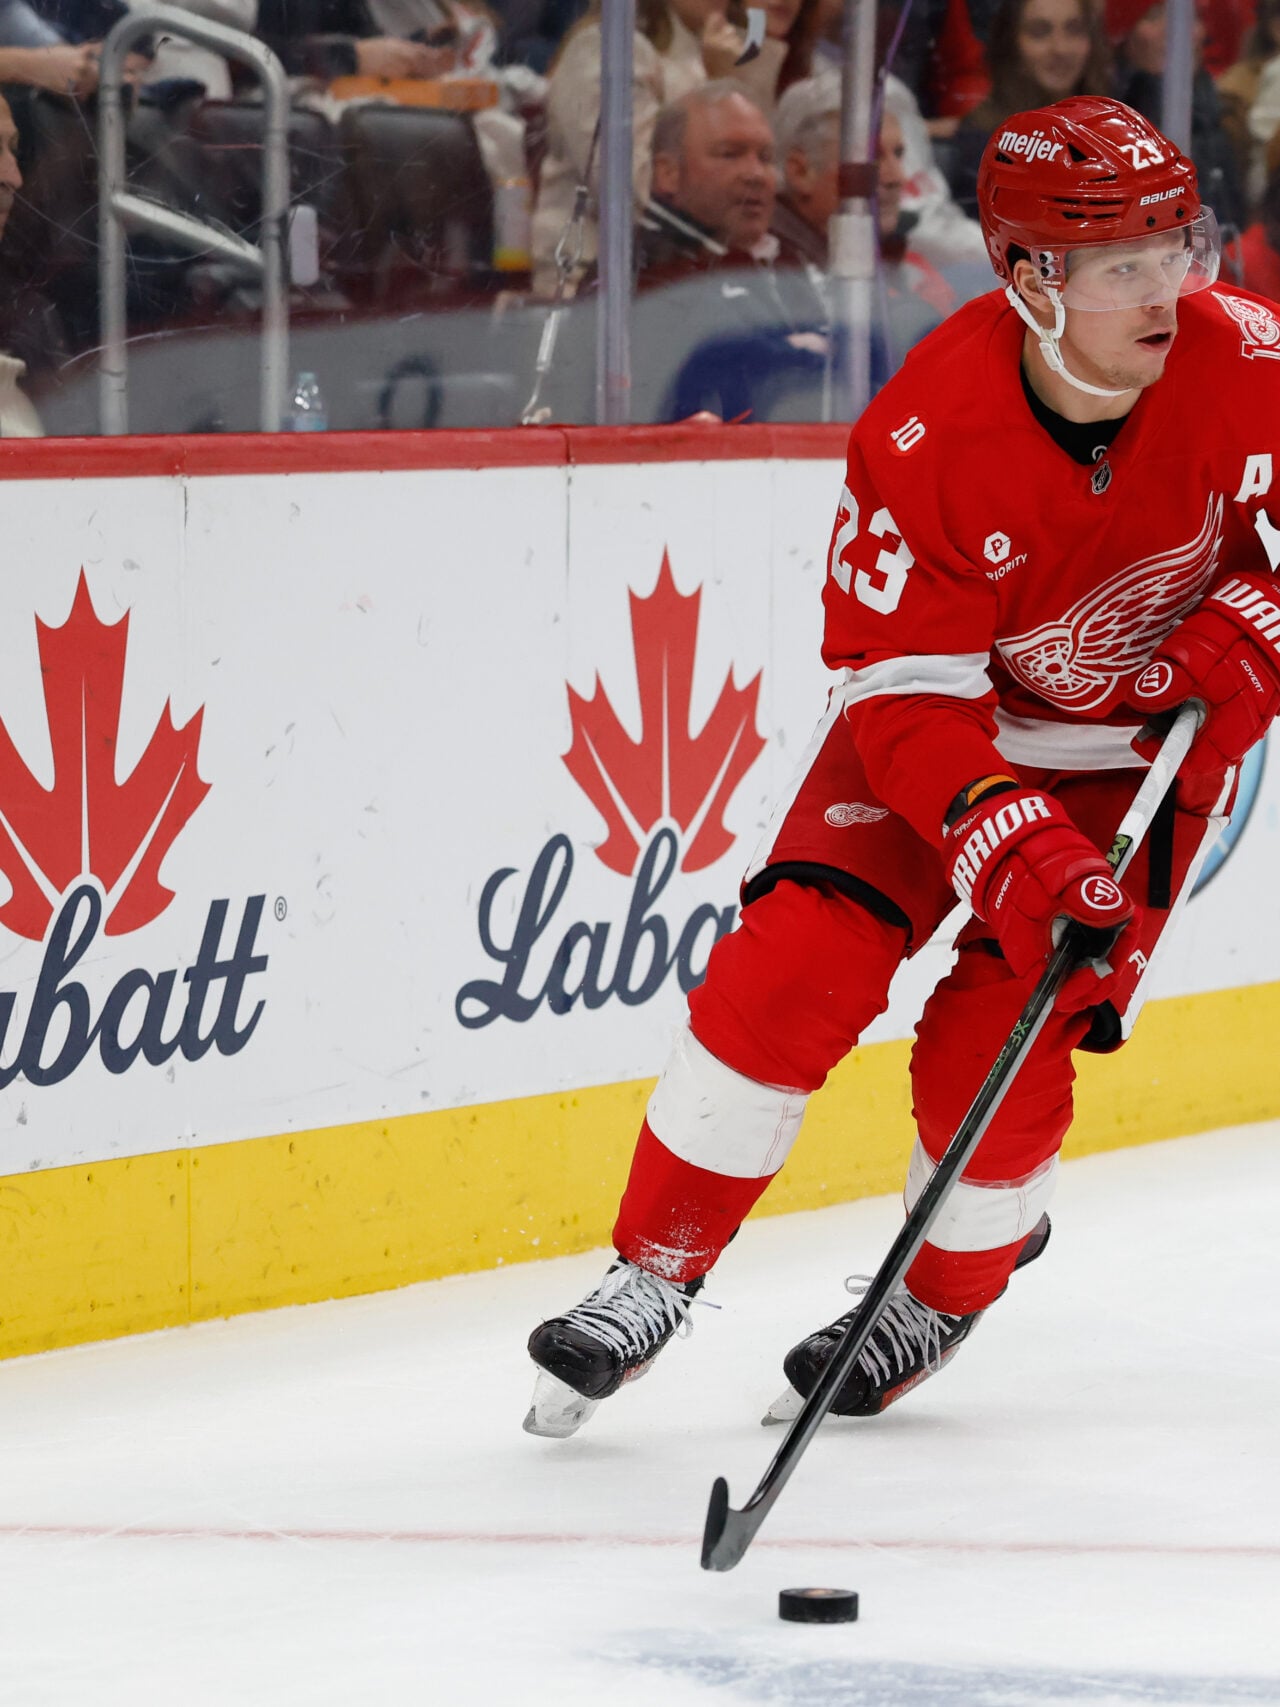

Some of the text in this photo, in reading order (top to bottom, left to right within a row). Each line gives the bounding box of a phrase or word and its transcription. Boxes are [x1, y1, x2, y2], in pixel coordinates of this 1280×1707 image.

[999, 130, 1063, 162] meijer
[1120, 138, 1165, 170] 23
[1139, 186, 1185, 206] BAUER
[890, 416, 926, 451] 10
[1234, 453, 1272, 503] A
[831, 483, 916, 615] 23
[1240, 659, 1264, 693] COVERT
[994, 871, 1014, 909] COVERT
